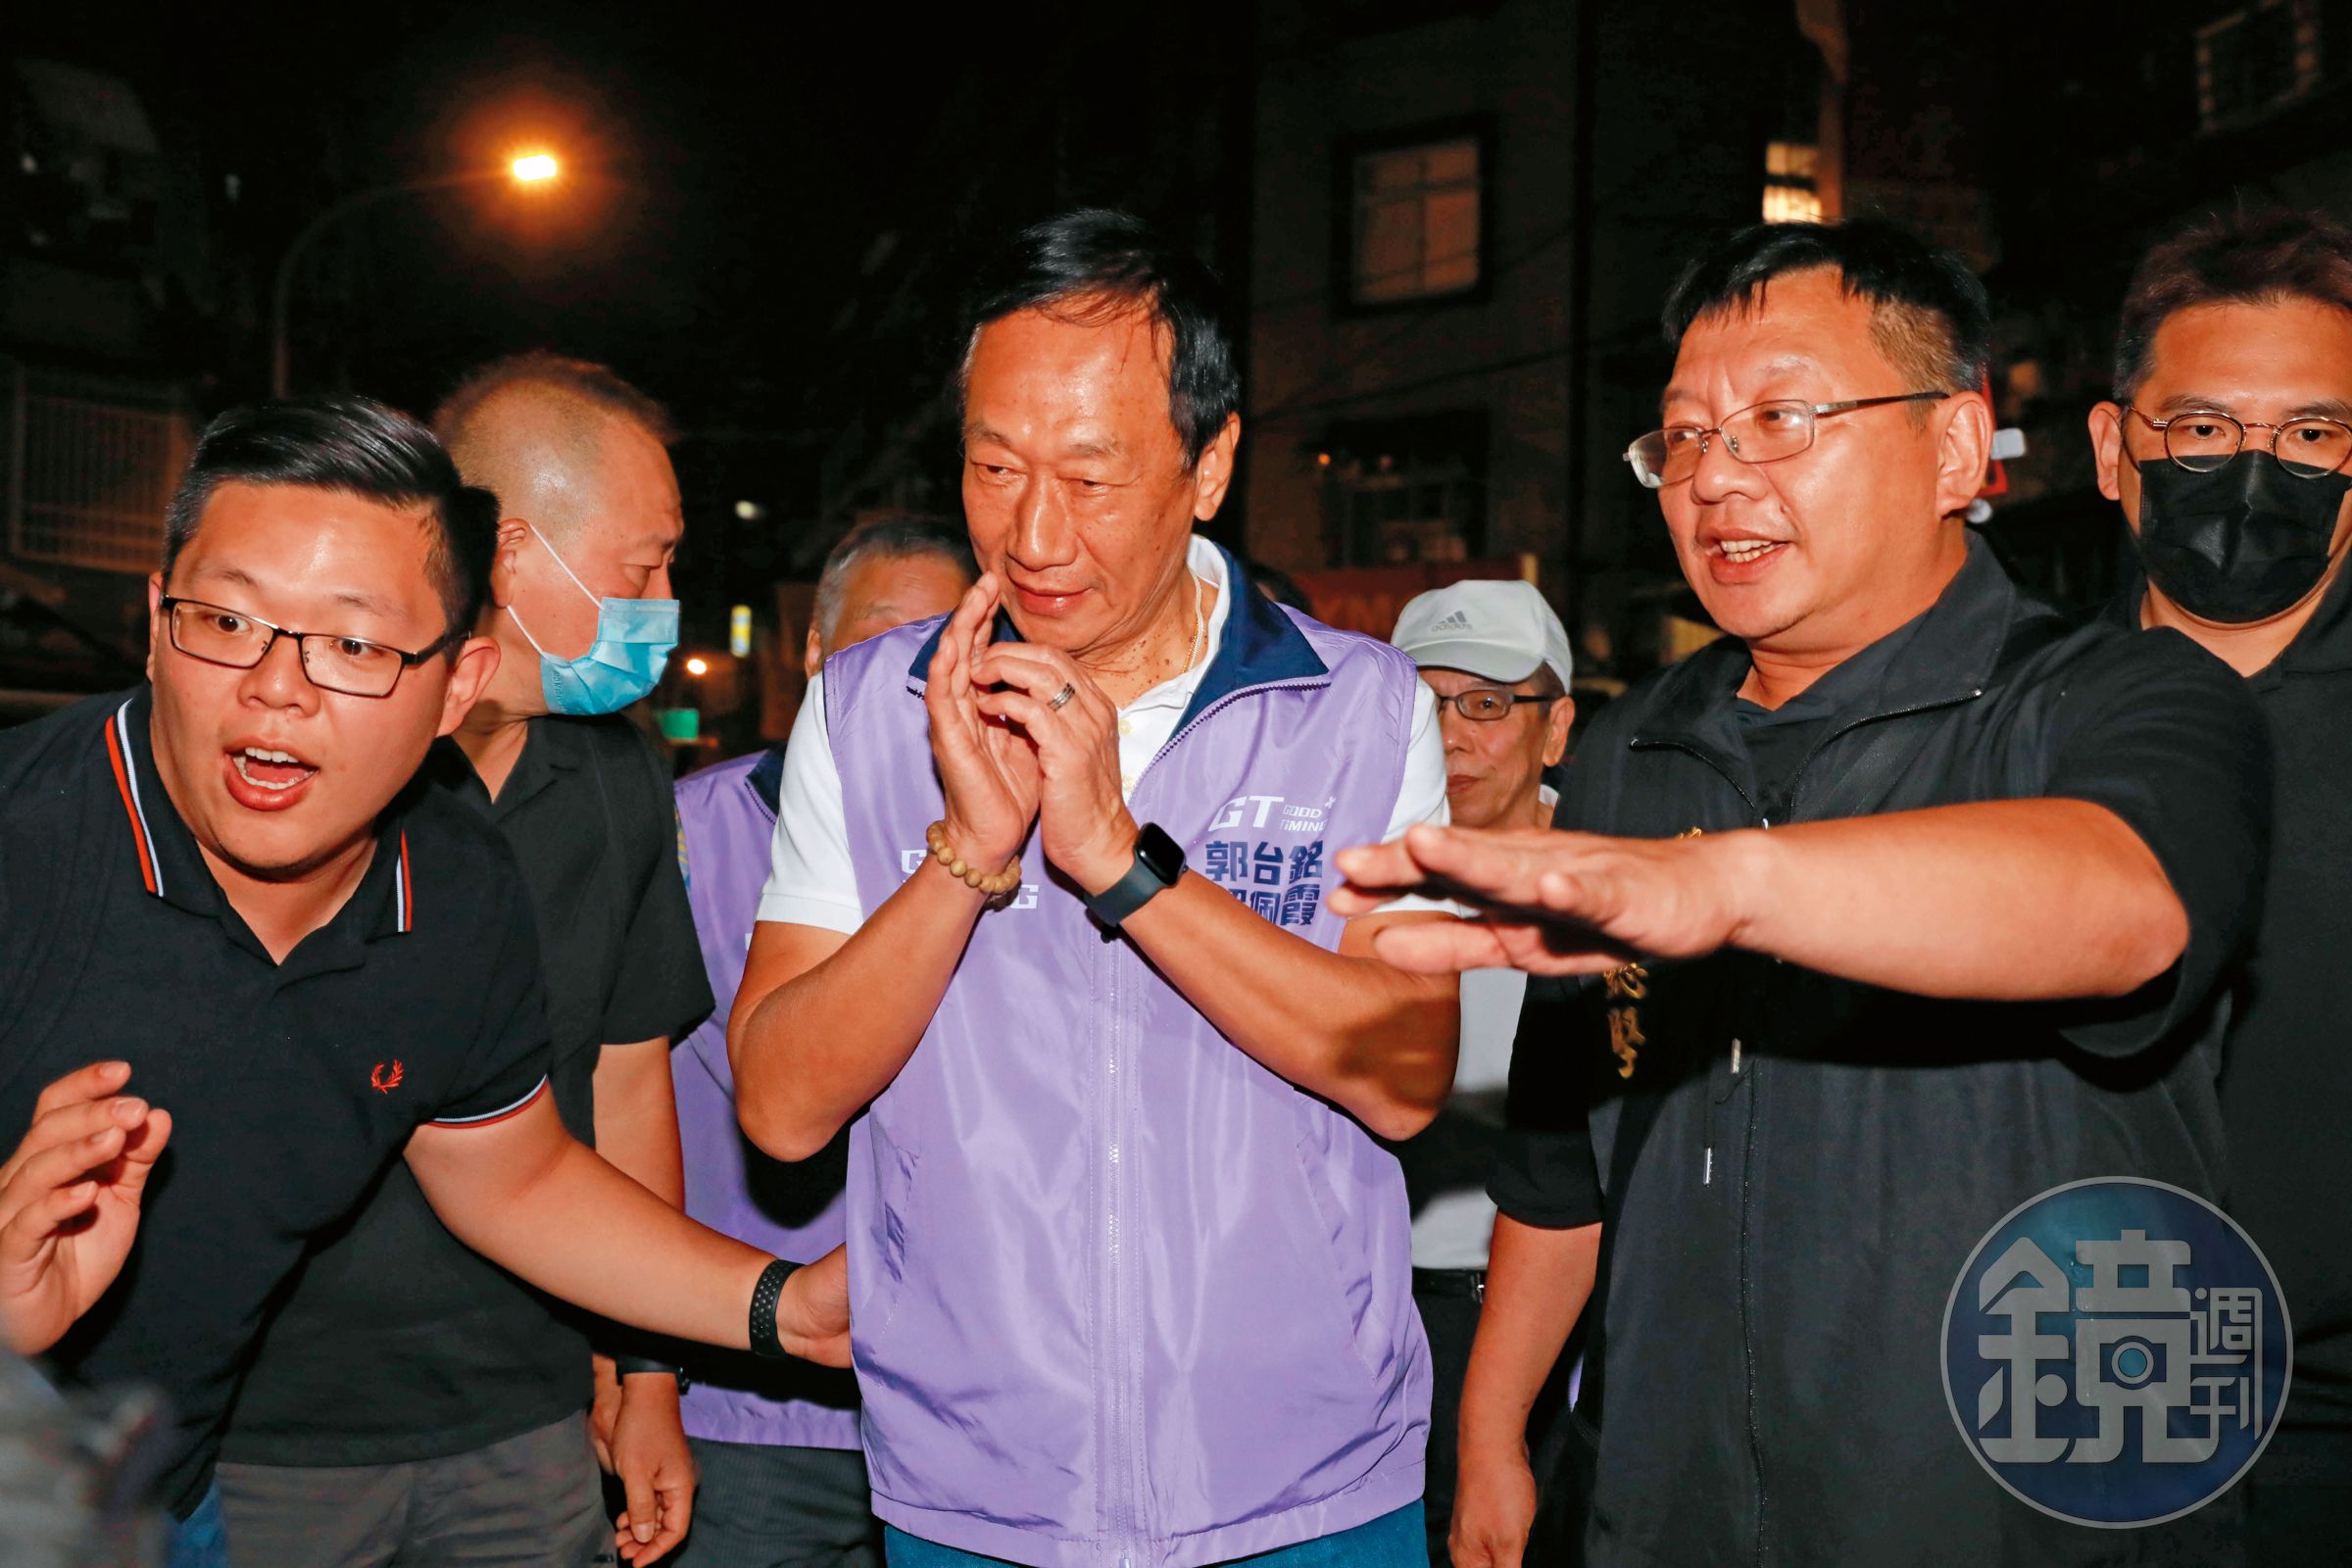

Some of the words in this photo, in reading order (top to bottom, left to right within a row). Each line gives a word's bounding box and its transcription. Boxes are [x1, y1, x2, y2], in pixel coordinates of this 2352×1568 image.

[1431, 622, 1473, 633] adidas
[1207, 795, 1285, 832] GT
[1283, 804, 1322, 818] GOOD
[1205, 840, 1323, 885] 郭台銘
[1228, 883, 1321, 926] 佩霞
